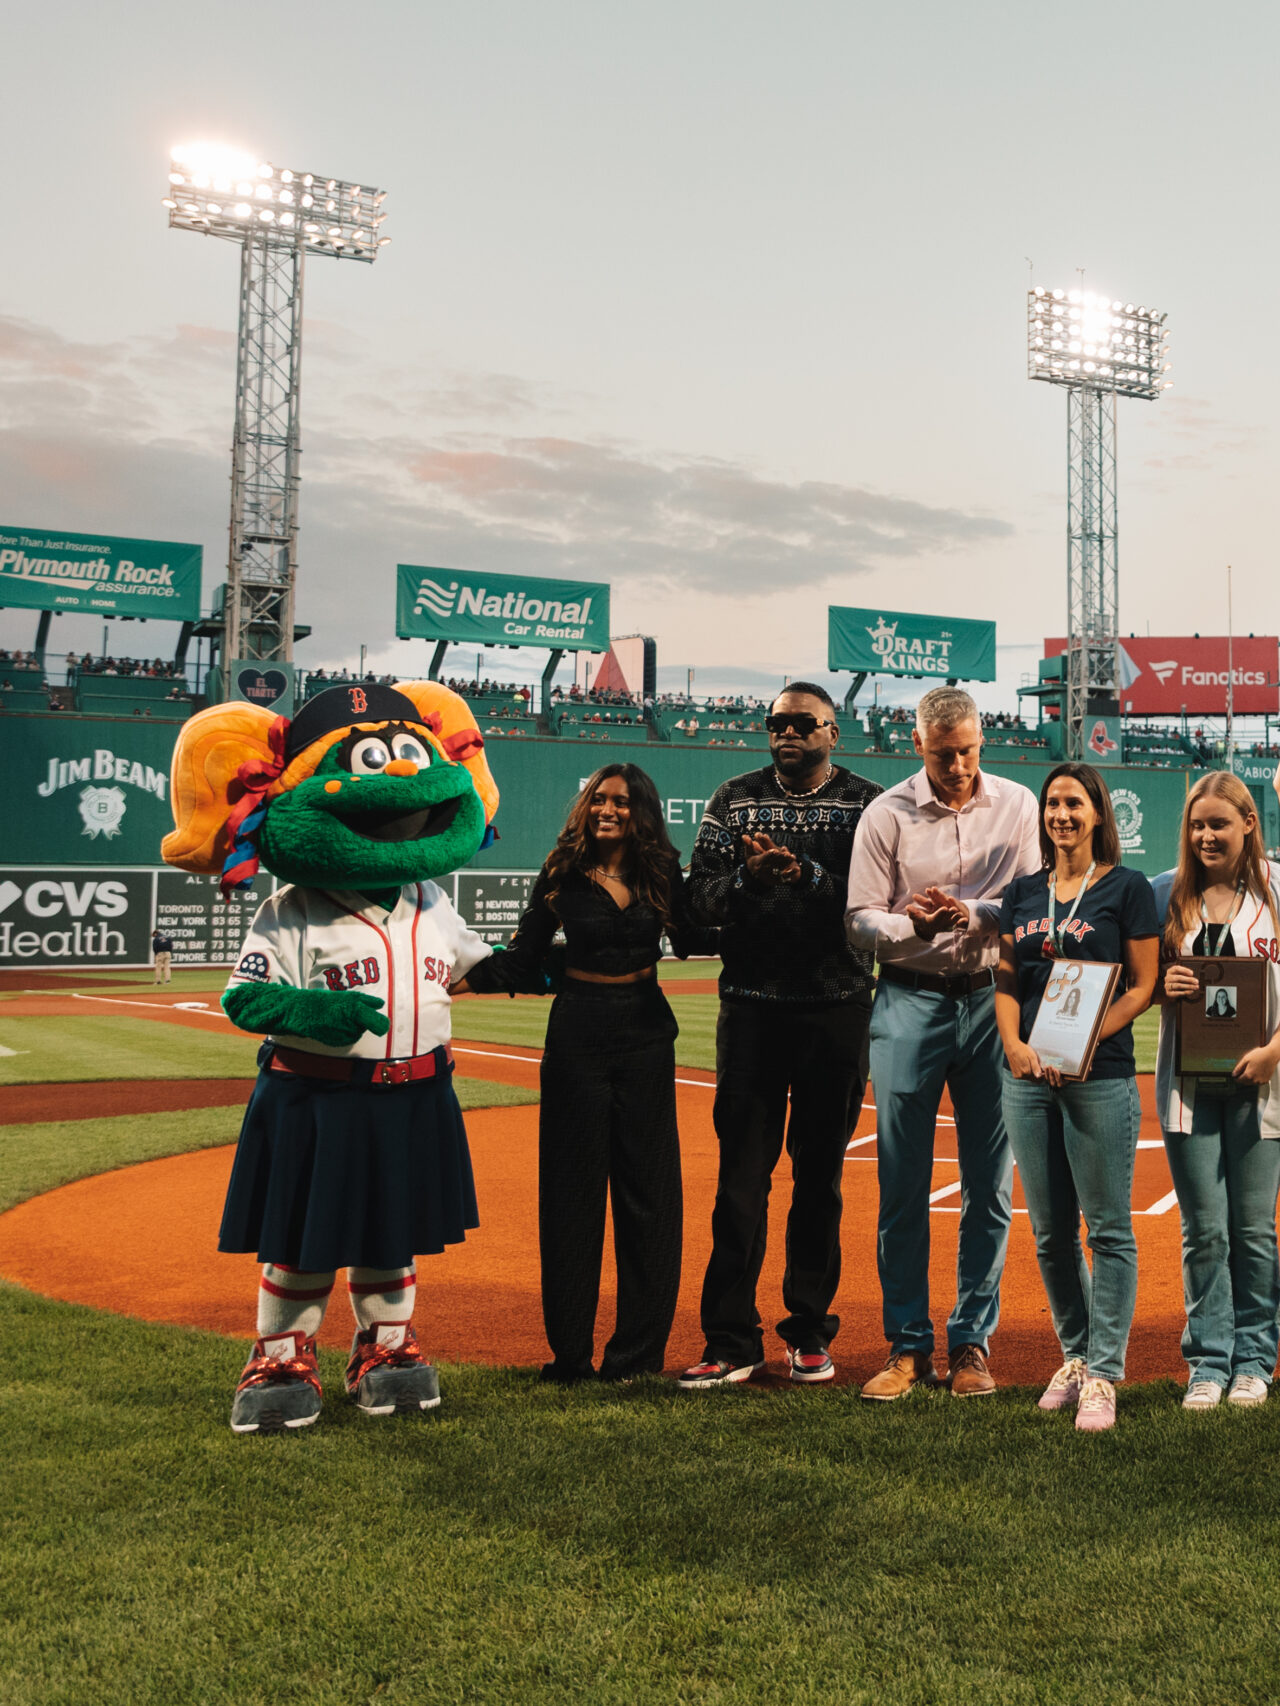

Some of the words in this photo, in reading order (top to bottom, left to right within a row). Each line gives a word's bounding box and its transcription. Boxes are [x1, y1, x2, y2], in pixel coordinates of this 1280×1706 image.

[0, 535, 18, 545] ore
[20, 536, 43, 548] Than
[44, 539, 64, 549] Just
[65, 541, 112, 554] Insurance.
[0, 549, 110, 581] Plymouth
[115, 560, 175, 585] Rock
[95, 580, 174, 597] assurance
[55, 596, 80, 604] AUTO
[91, 599, 116, 607] HOME
[457, 587, 593, 624] National
[504, 622, 530, 636] Car
[535, 624, 585, 640] Rental
[872, 634, 952, 657] DRAFT
[882, 652, 949, 673] KINGS
[256, 677, 267, 687] EL
[1182, 666, 1266, 686] Fanatics
[348, 687, 368, 713] B
[38, 757, 91, 797] JIM
[94, 749, 167, 801] BEAM
[660, 798, 711, 824] ET
[186, 876, 203, 884] AL
[24, 880, 129, 917] CVS
[232, 892, 238, 900] L
[244, 892, 258, 900] GB
[159, 905, 204, 913] TORONTO
[212, 905, 226, 913] 87
[228, 905, 241, 913] 62
[486, 912, 519, 920] BOSTON
[158, 917, 178, 926] NEW
[183, 917, 207, 926] YORK
[212, 917, 225, 926] 83
[228, 917, 241, 926] 65
[1015, 918, 1051, 943] RED
[189, 941, 207, 949] BAY
[211, 941, 224, 949] 73
[228, 941, 240, 949] 76
[171, 953, 207, 961] TIMORE
[211, 952, 224, 961] 69
[227, 952, 240, 961] 80
[323, 957, 380, 991] RED
[424, 957, 451, 989] SOX
